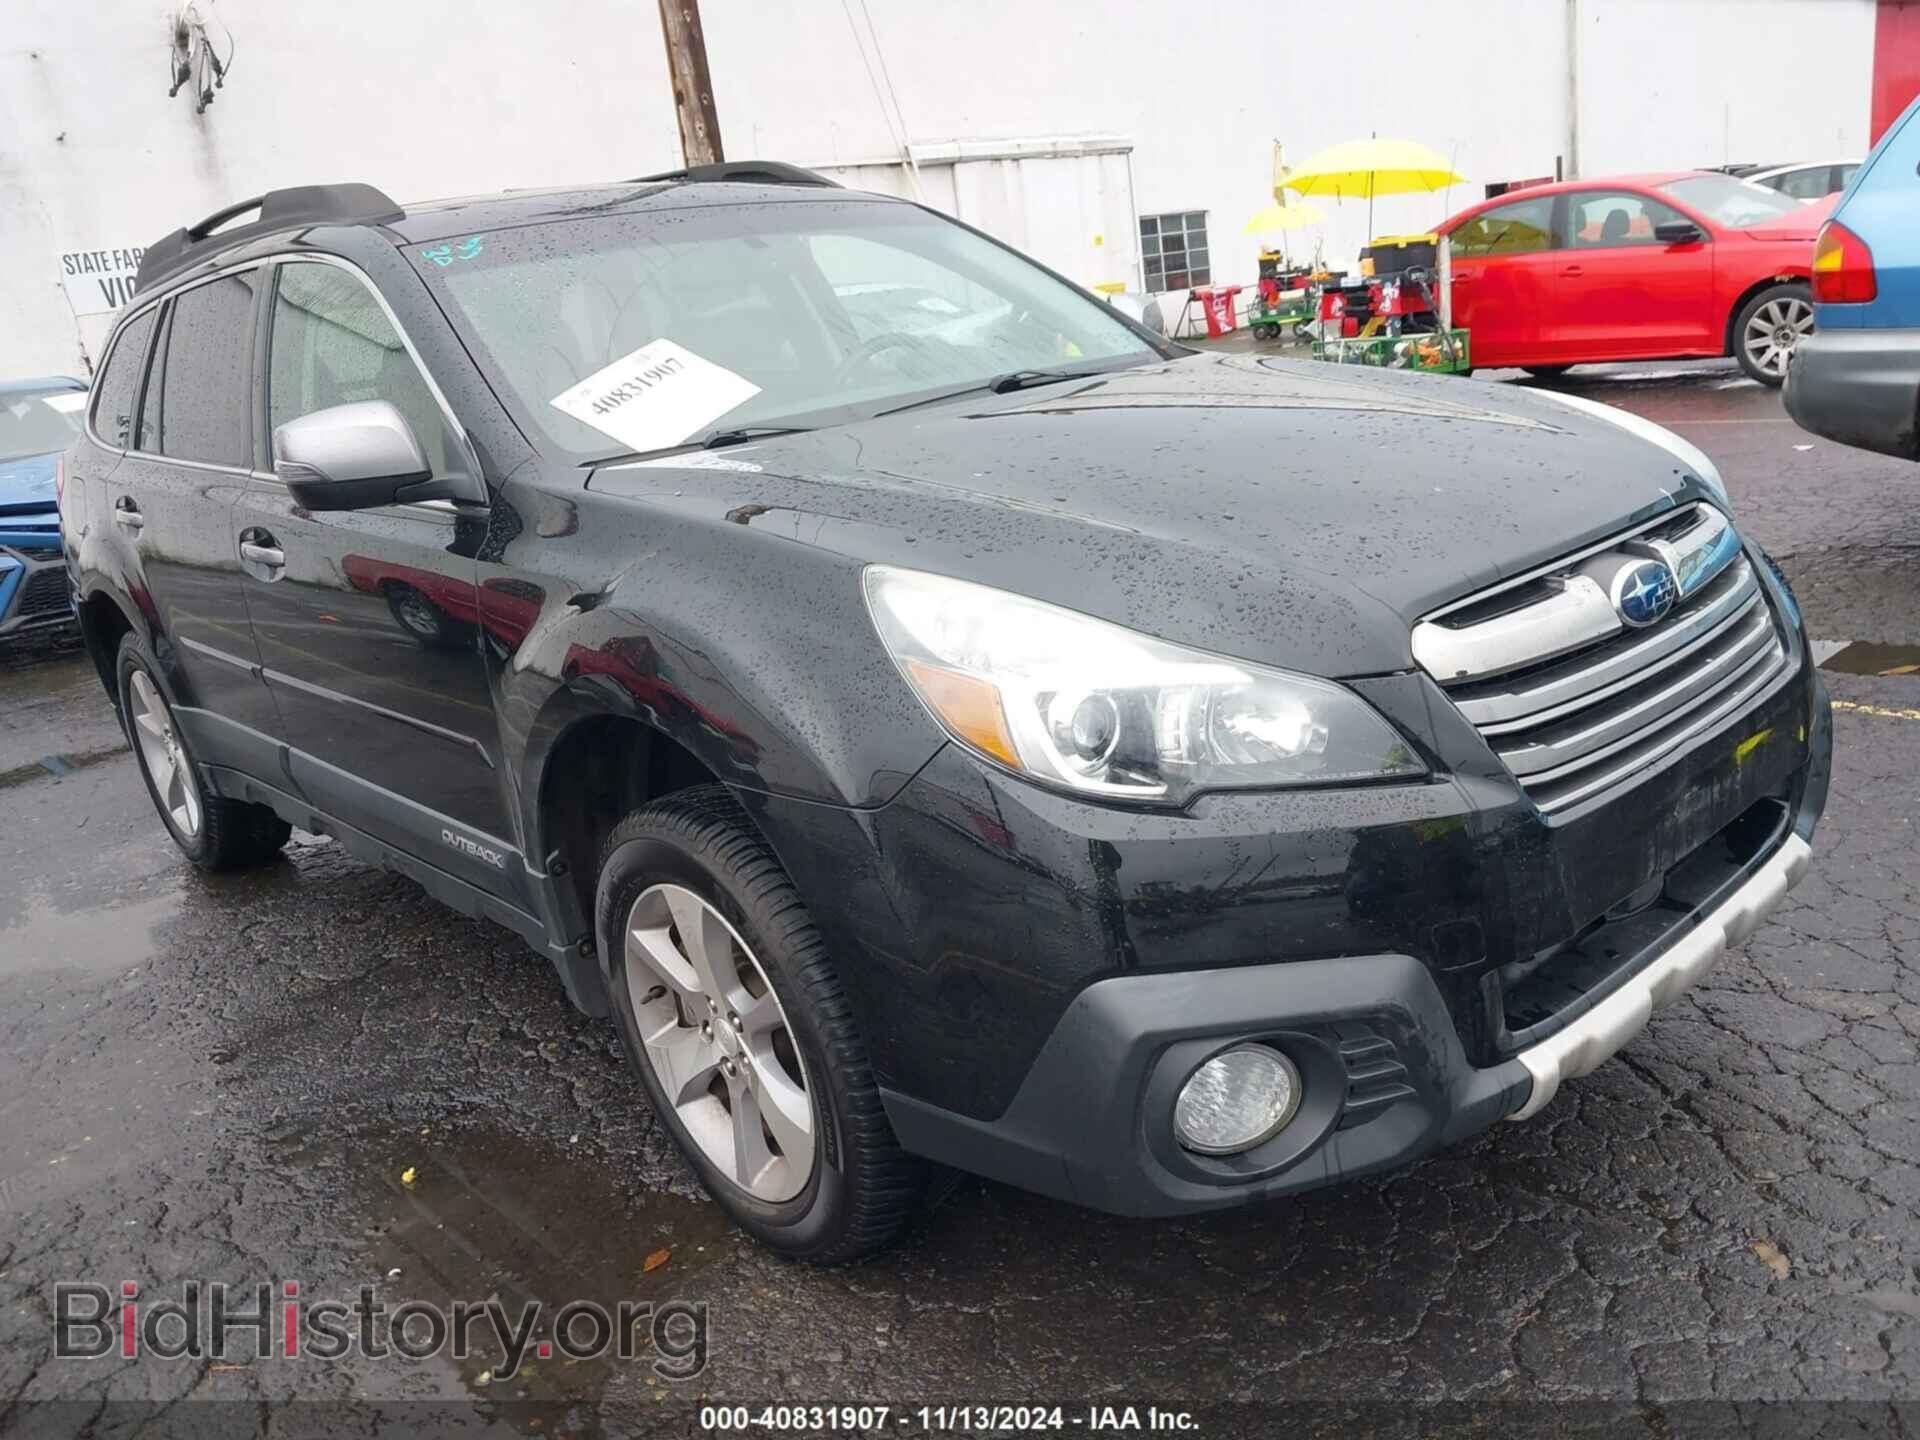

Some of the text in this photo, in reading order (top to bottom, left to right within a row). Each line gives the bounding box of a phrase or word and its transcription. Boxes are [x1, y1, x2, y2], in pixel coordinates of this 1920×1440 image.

[62, 247, 149, 276] STATE FAR
[592, 357, 686, 415] 40831907
[441, 829, 504, 869] OUTBACK
